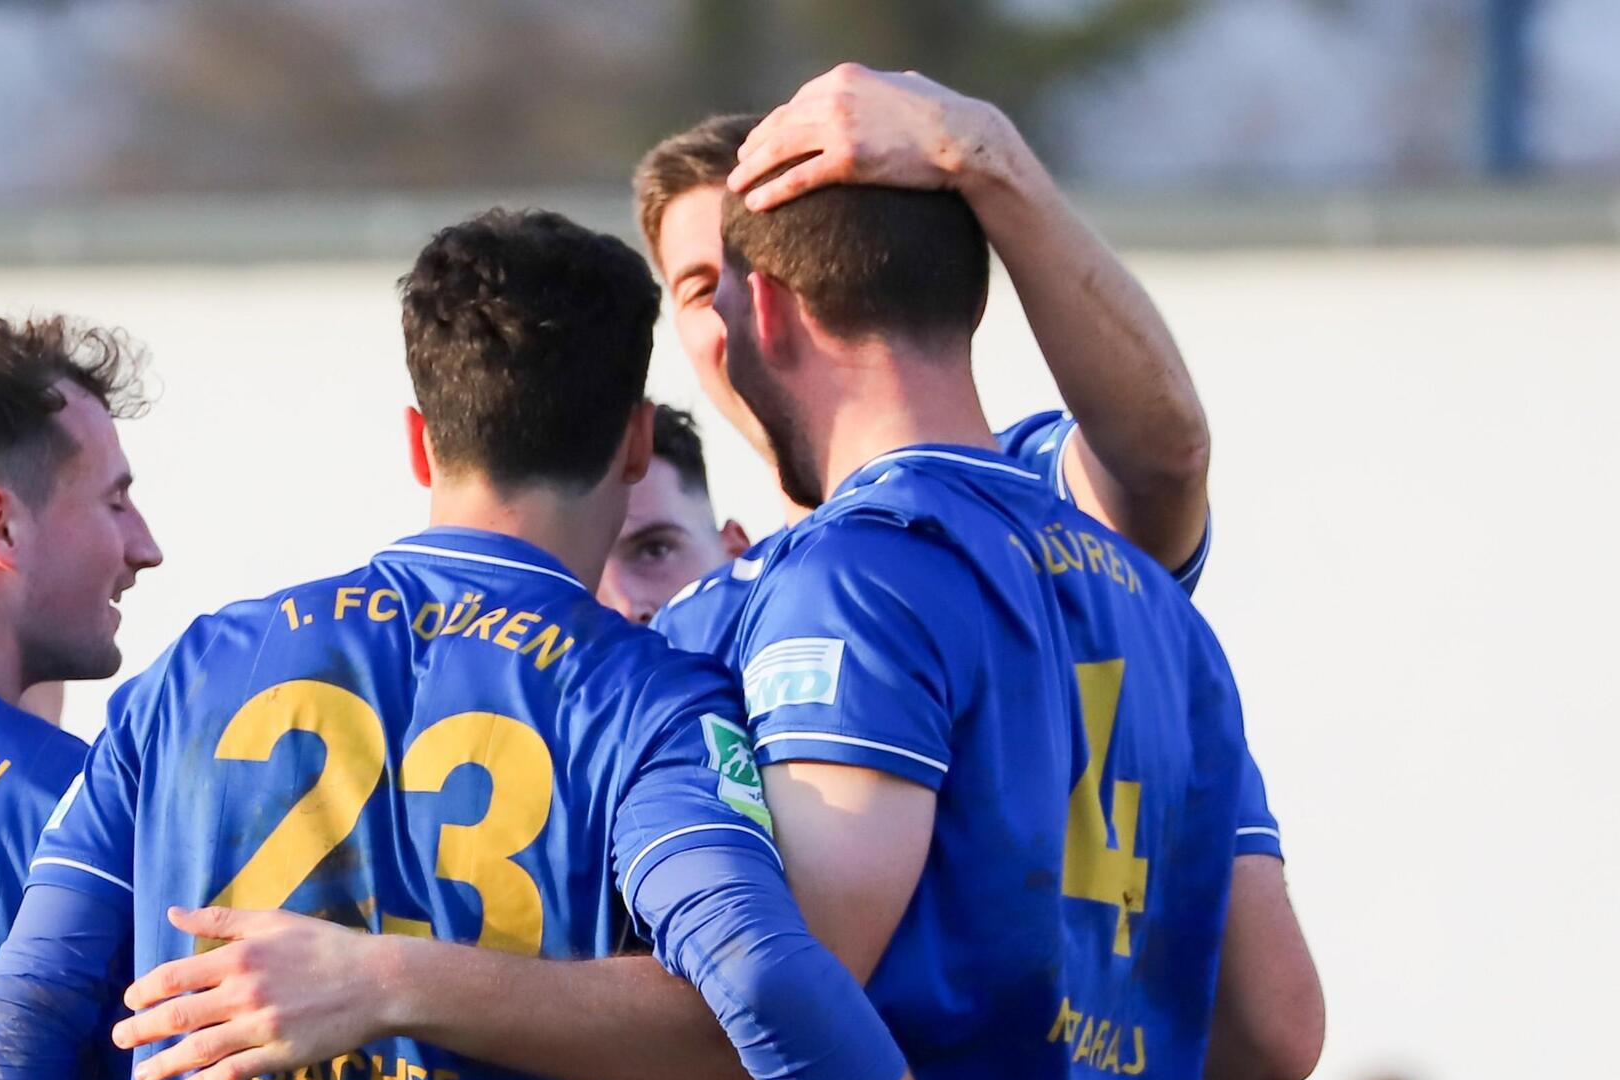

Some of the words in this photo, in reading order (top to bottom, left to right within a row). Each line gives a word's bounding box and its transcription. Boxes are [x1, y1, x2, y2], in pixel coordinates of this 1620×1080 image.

[281, 597, 313, 631] 1.
[333, 586, 400, 621] FC
[412, 592, 575, 672] DÜREN
[193, 678, 554, 958] 23
[1061, 658, 1149, 957] 4
